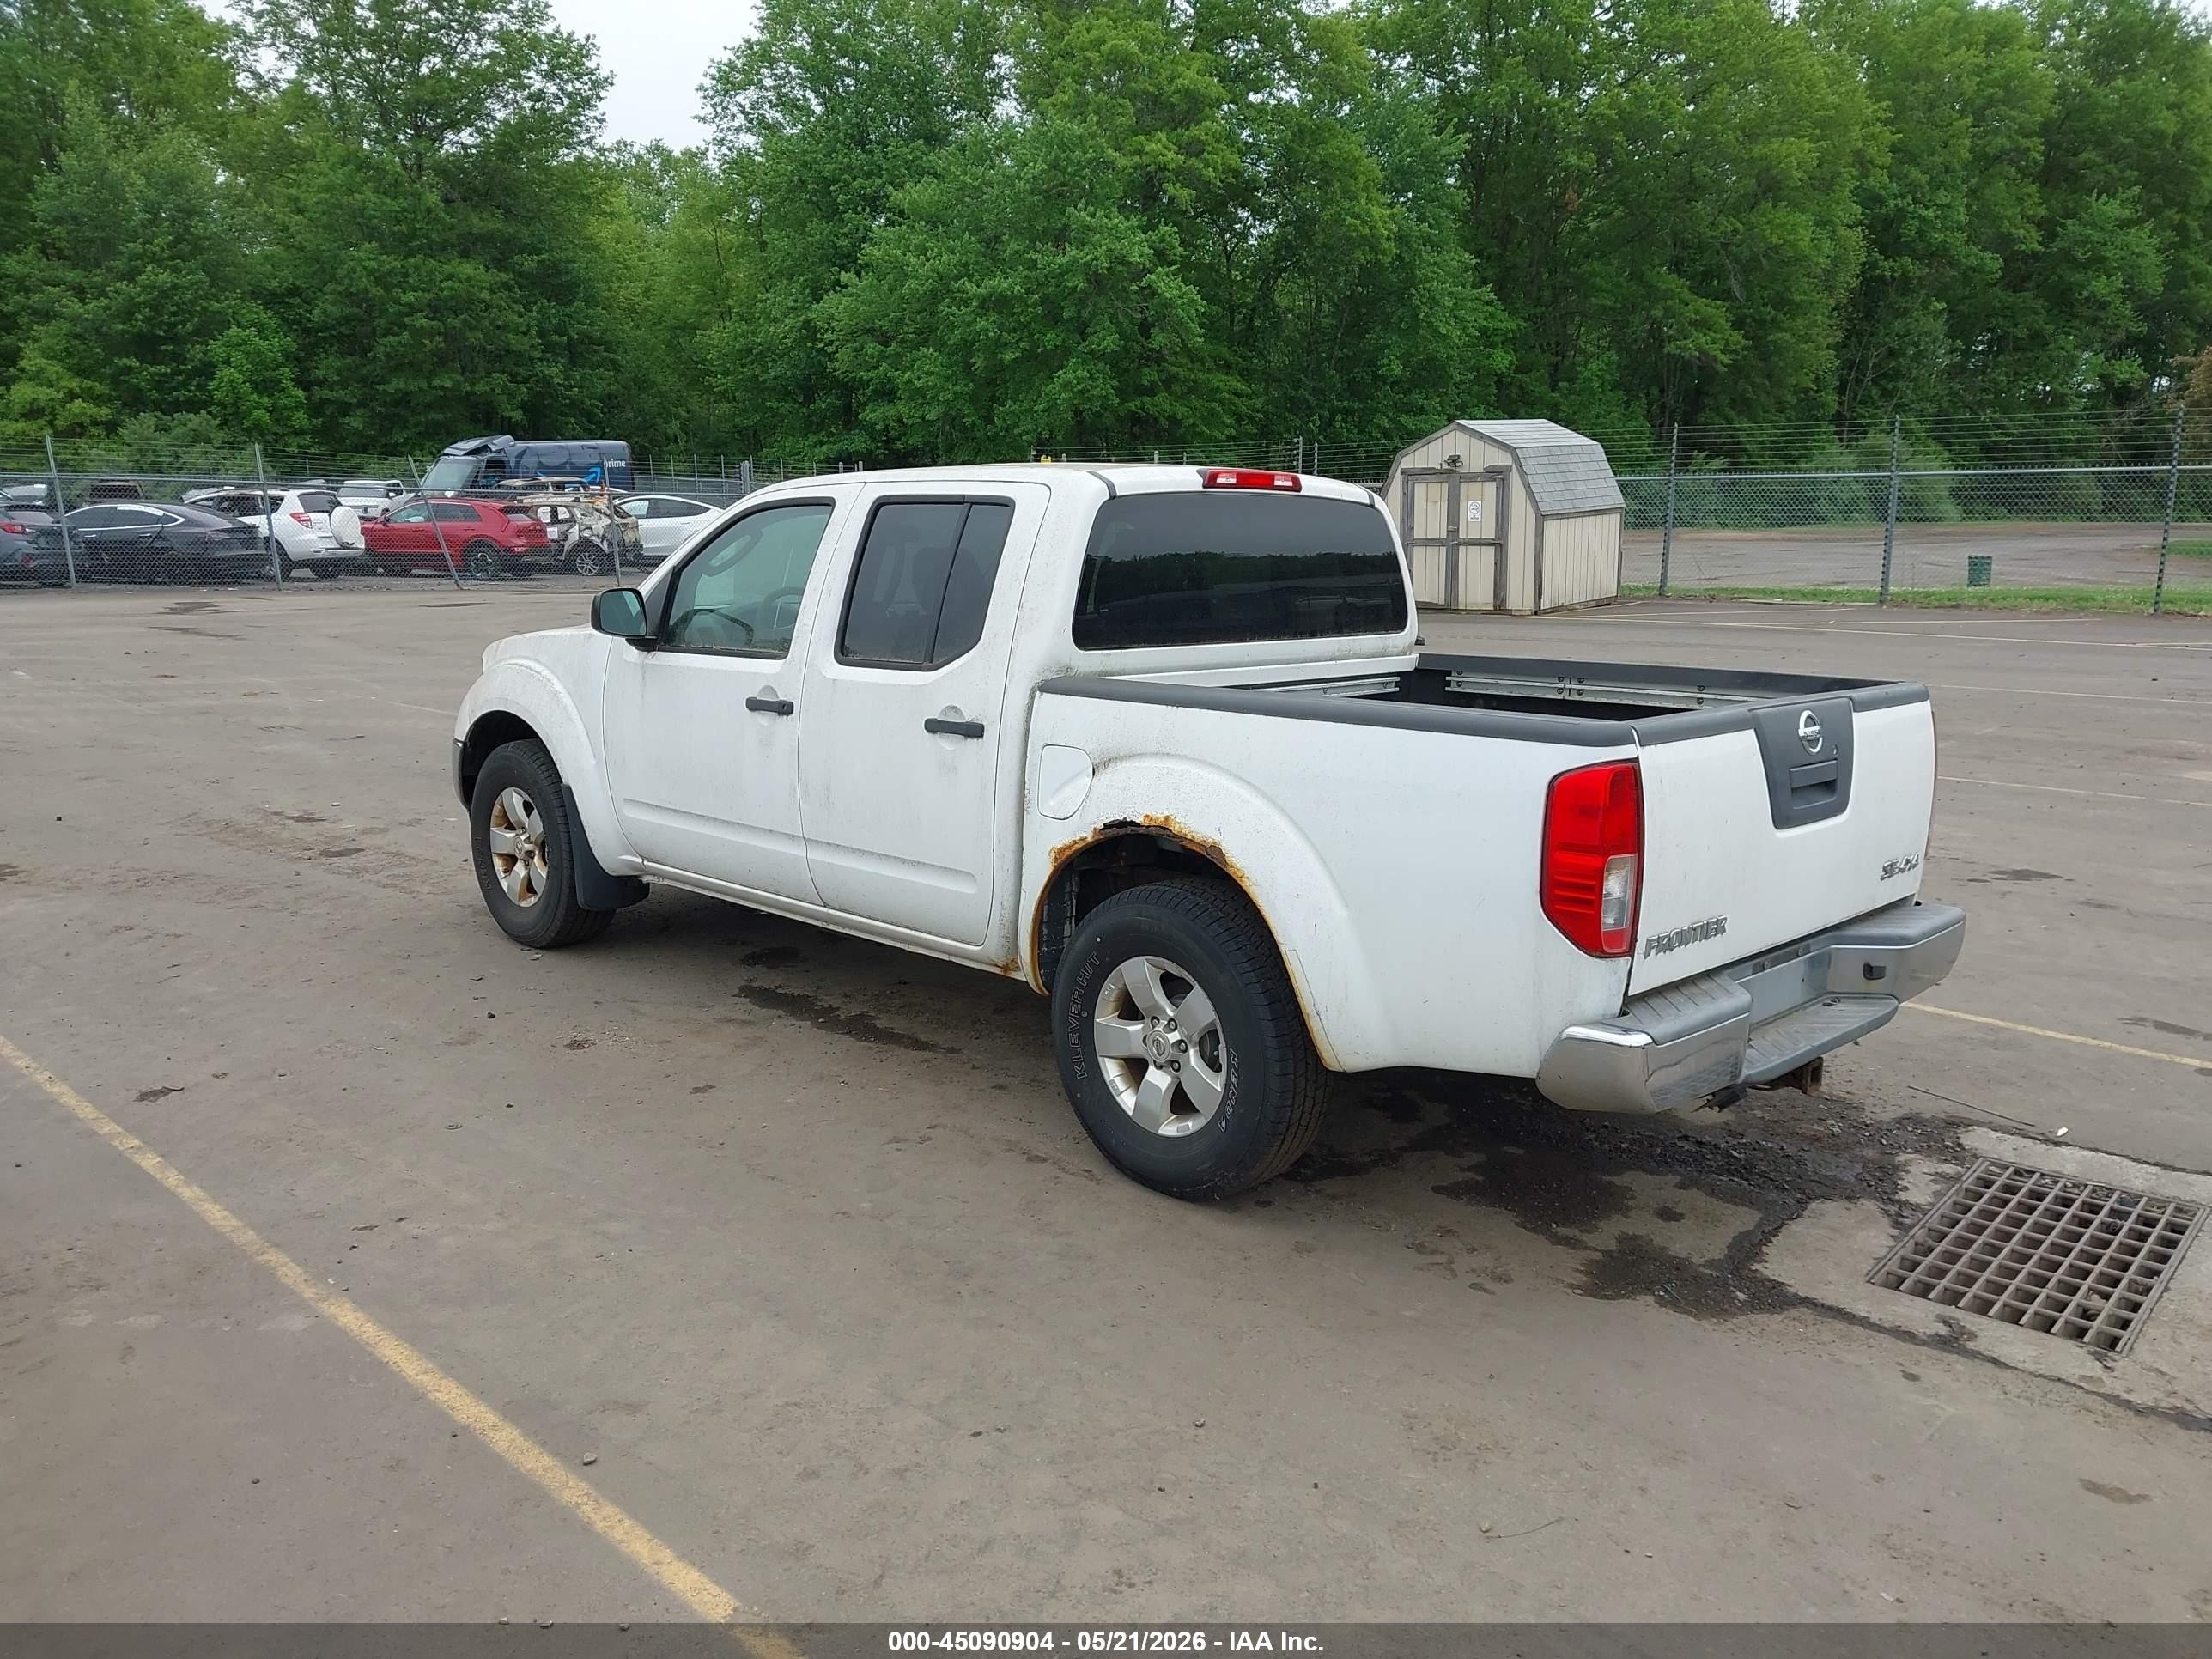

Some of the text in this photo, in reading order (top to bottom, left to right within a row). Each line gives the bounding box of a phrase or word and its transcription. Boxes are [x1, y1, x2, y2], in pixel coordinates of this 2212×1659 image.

[1644, 915, 1728, 960] FRONTIER
[1067, 988, 1088, 1079] KLEVER
[1218, 1048, 1238, 1133] KENDA
